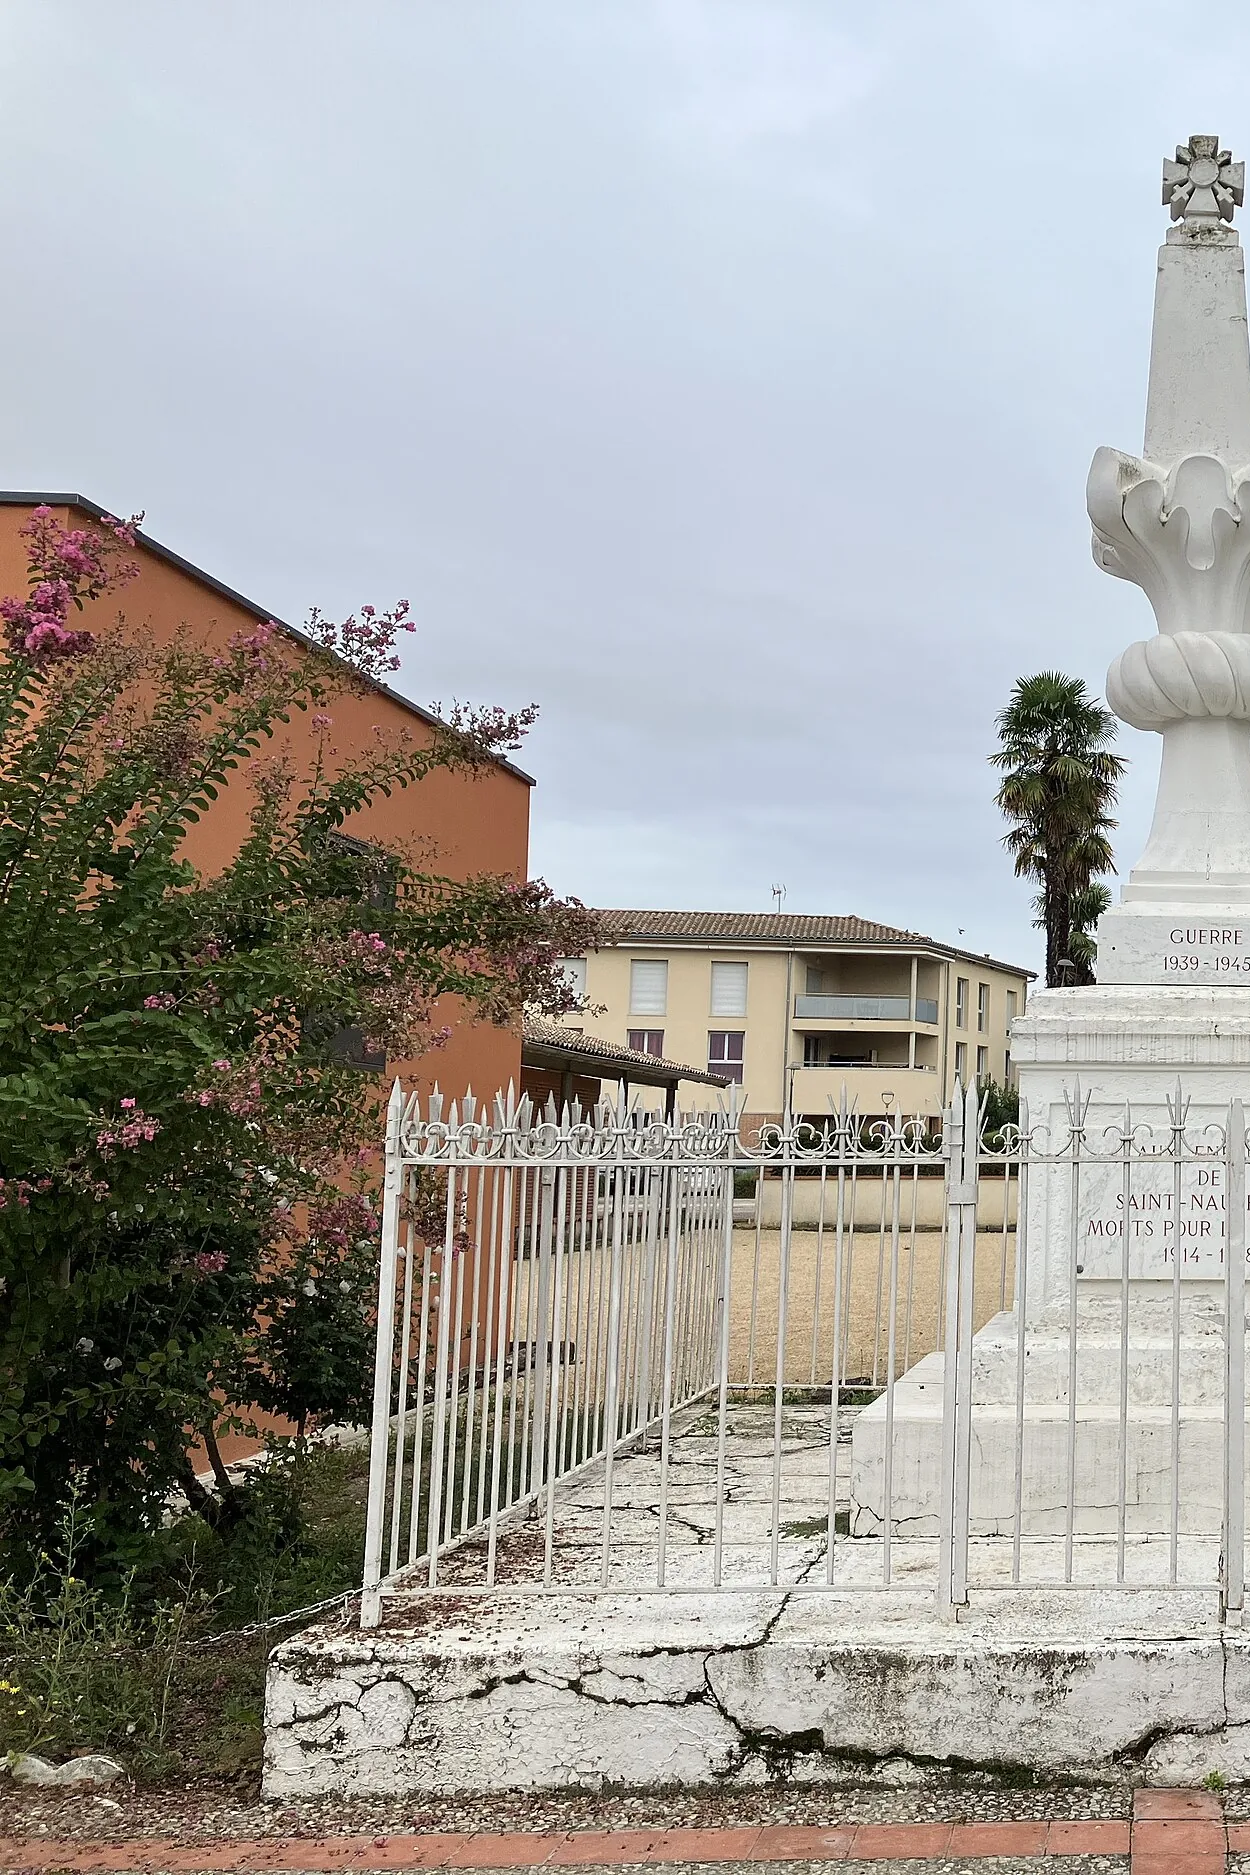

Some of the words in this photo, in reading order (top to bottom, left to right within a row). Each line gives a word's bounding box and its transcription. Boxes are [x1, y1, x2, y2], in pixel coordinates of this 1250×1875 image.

[1169, 929, 1243, 945] GUERRE
[1198, 1169, 1221, 1186] DE
[1163, 1220, 1212, 1237] POUR
